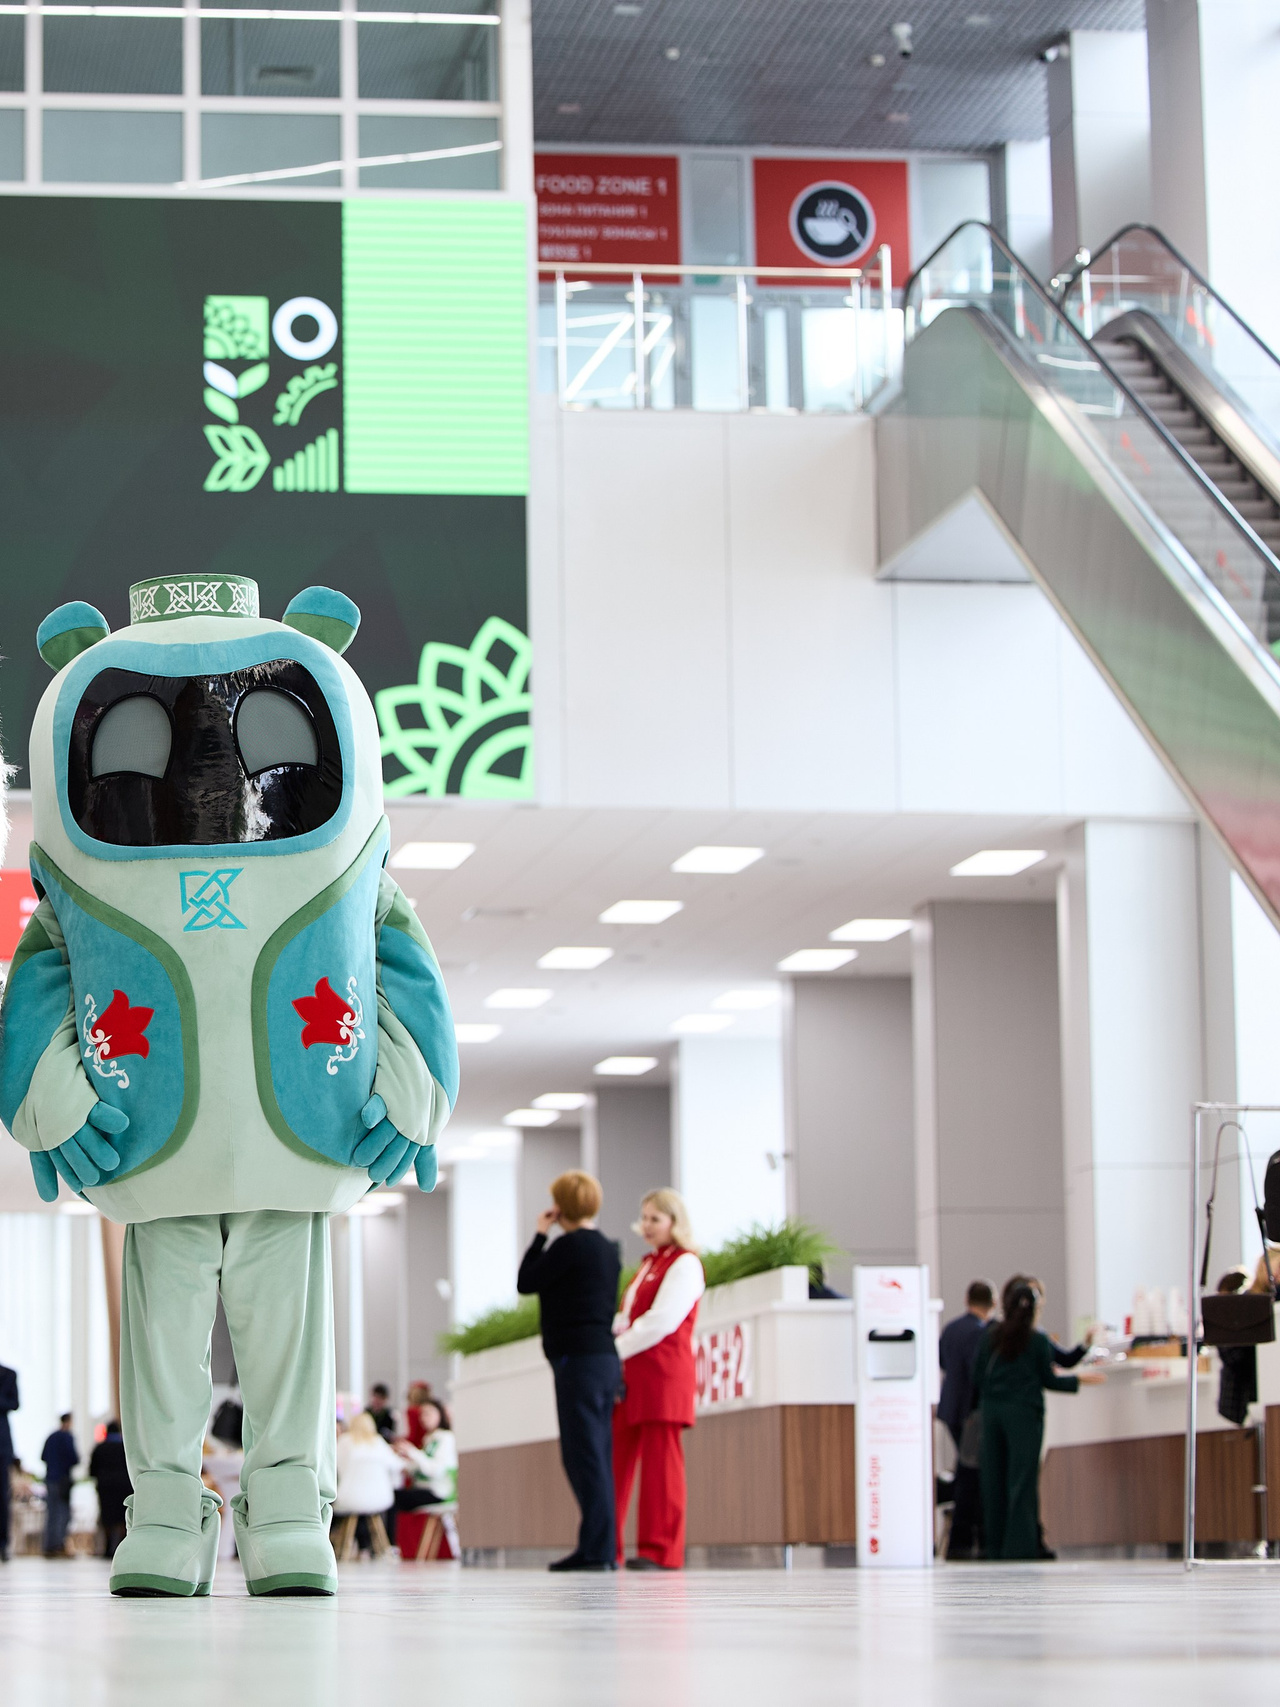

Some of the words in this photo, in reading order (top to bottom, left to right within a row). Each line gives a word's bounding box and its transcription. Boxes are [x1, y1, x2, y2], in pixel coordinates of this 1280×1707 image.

[536, 174, 594, 195] FOOD
[596, 175, 652, 196] ZONE
[656, 177, 668, 197] 1
